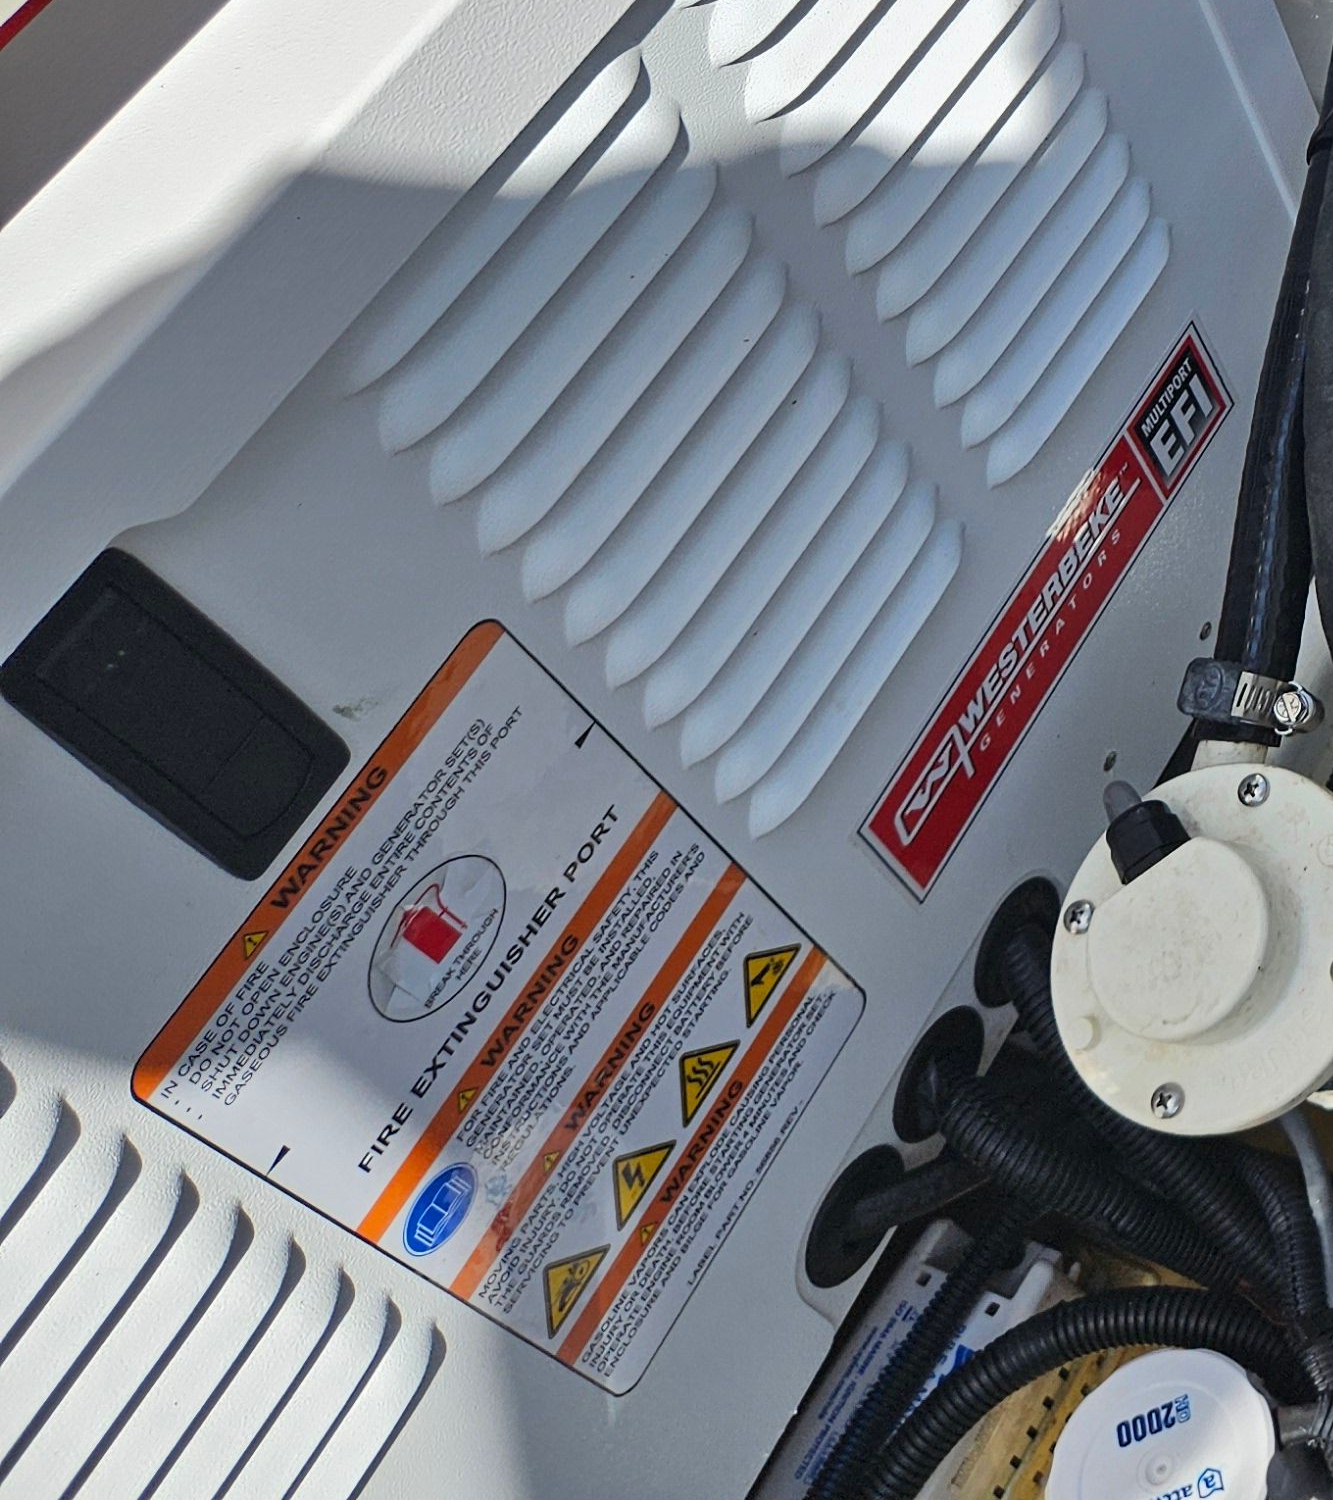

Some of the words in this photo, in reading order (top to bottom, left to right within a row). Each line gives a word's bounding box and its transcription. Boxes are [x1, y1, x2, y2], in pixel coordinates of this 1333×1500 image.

[1136, 354, 1199, 438] MULTIPORT
[1139, 373, 1225, 476] EFI
[974, 524, 1128, 754] GENERATORS
[198, 1041, 242, 1093] SHUT
[238, 987, 283, 1041] DOWN
[278, 901, 347, 988] ENGINE(S)
[342, 866, 374, 904] AND
[370, 767, 448, 868] GENERATOR
[443, 715, 487, 770] SET(S)
[221, 1021, 290, 1108] GASEOUS
[285, 981, 320, 1023] FIRE
[313, 862, 409, 984] EXTINGUISHER
[403, 783, 466, 865] THROUGH
[462, 747, 493, 785] THIS
[489, 704, 525, 750] PORT
[268, 760, 391, 913] WARNING
[187, 1056, 213, 1085] DO
[209, 1018, 242, 1057] NOT
[239, 966, 282, 1018] OPEN
[275, 863, 359, 969] ENCLOSURE
[211, 985, 301, 1101] IMMEDIATELY
[296, 887, 373, 986] DISCHARGE
[369, 830, 416, 890] ENTIRE
[412, 745, 479, 833] CONTENTS
[475, 722, 497, 748] OF
[421, 964, 458, 1010] BREAK
[451, 904, 501, 969] THROUGH
[453, 944, 483, 983] HERE
[160, 1079, 179, 1099] IN
[176, 1028, 218, 1079] CASE
[213, 1000, 239, 1029] OF
[234, 959, 270, 1001] FIRE
[355, 1100, 416, 1175] FIRE
[408, 881, 567, 1100] EXTINGUISHER
[561, 800, 624, 885] PORT
[478, 930, 582, 1071] WARNING
[1112, 1399, 1179, 1447] 2000
